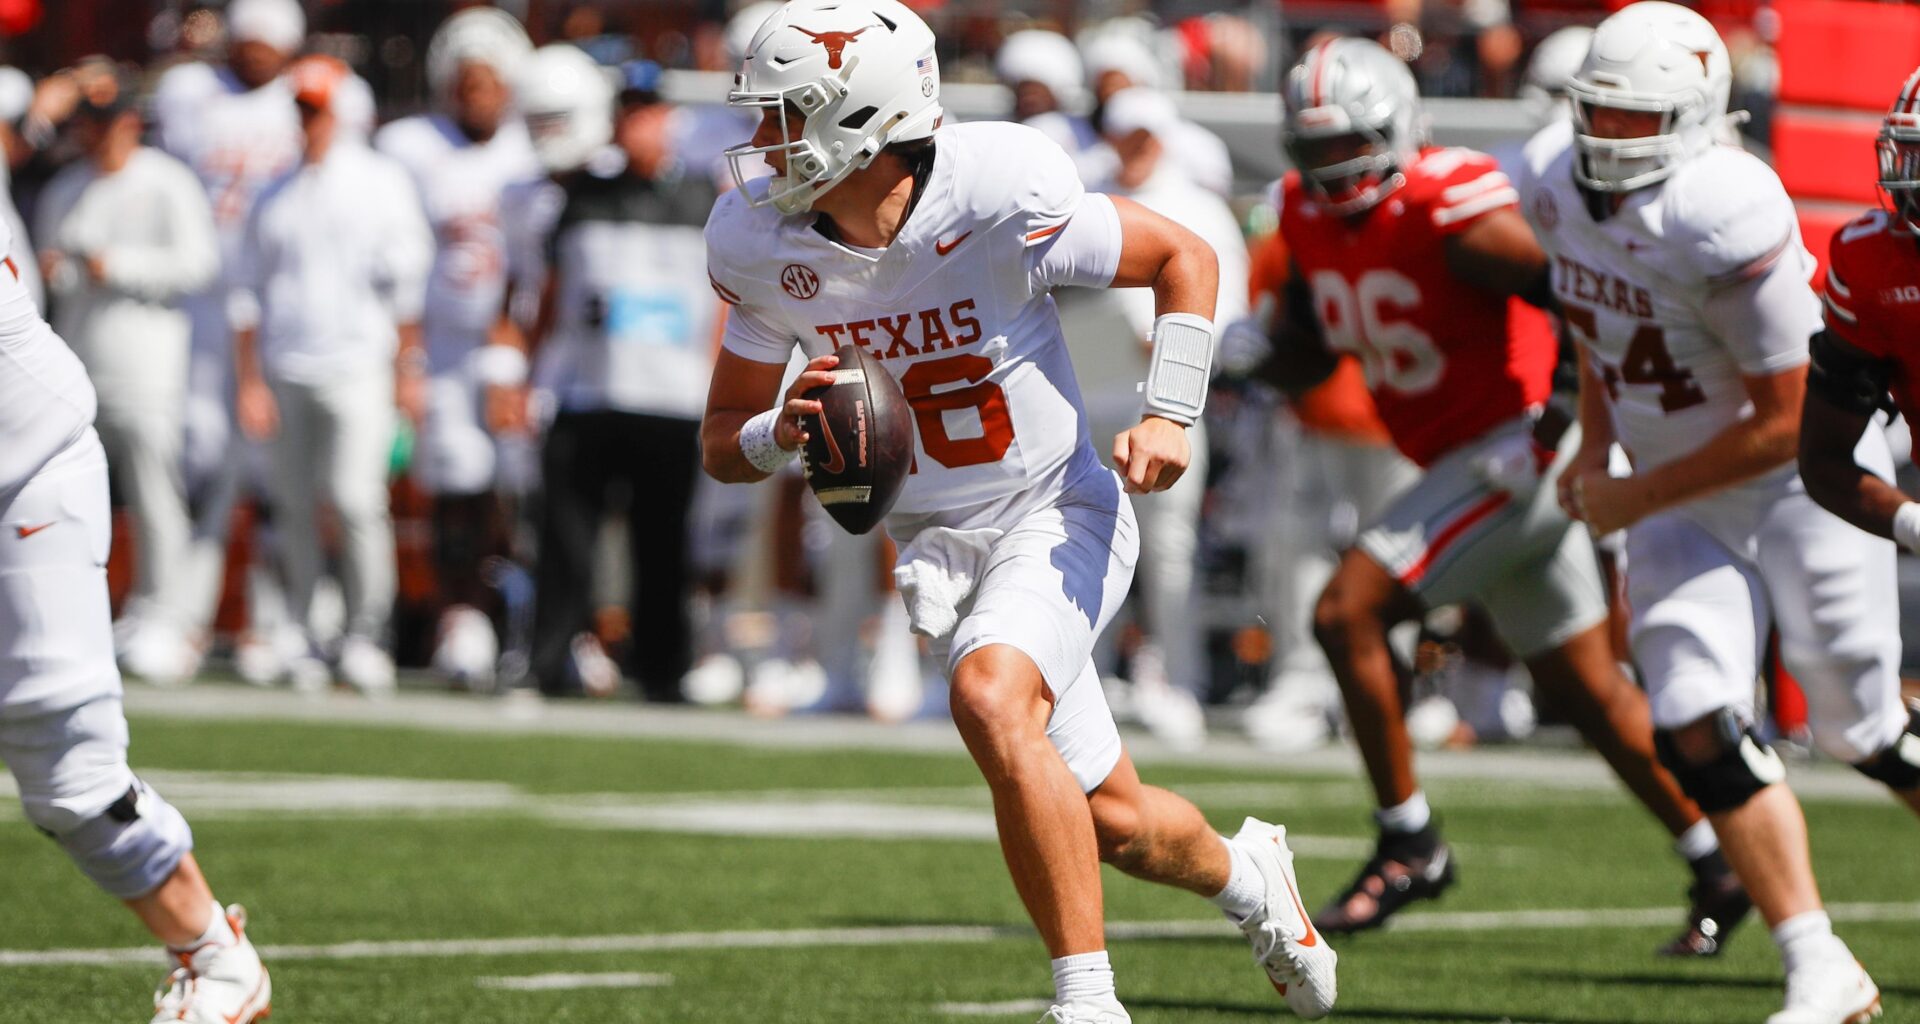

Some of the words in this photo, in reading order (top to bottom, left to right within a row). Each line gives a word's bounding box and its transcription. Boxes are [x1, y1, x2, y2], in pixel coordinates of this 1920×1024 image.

[782, 264, 819, 299] SEC
[1556, 254, 1654, 318] TEXAS
[815, 298, 982, 361] TEXAS
[1313, 268, 1447, 395] 96
[900, 352, 1015, 475] 6
